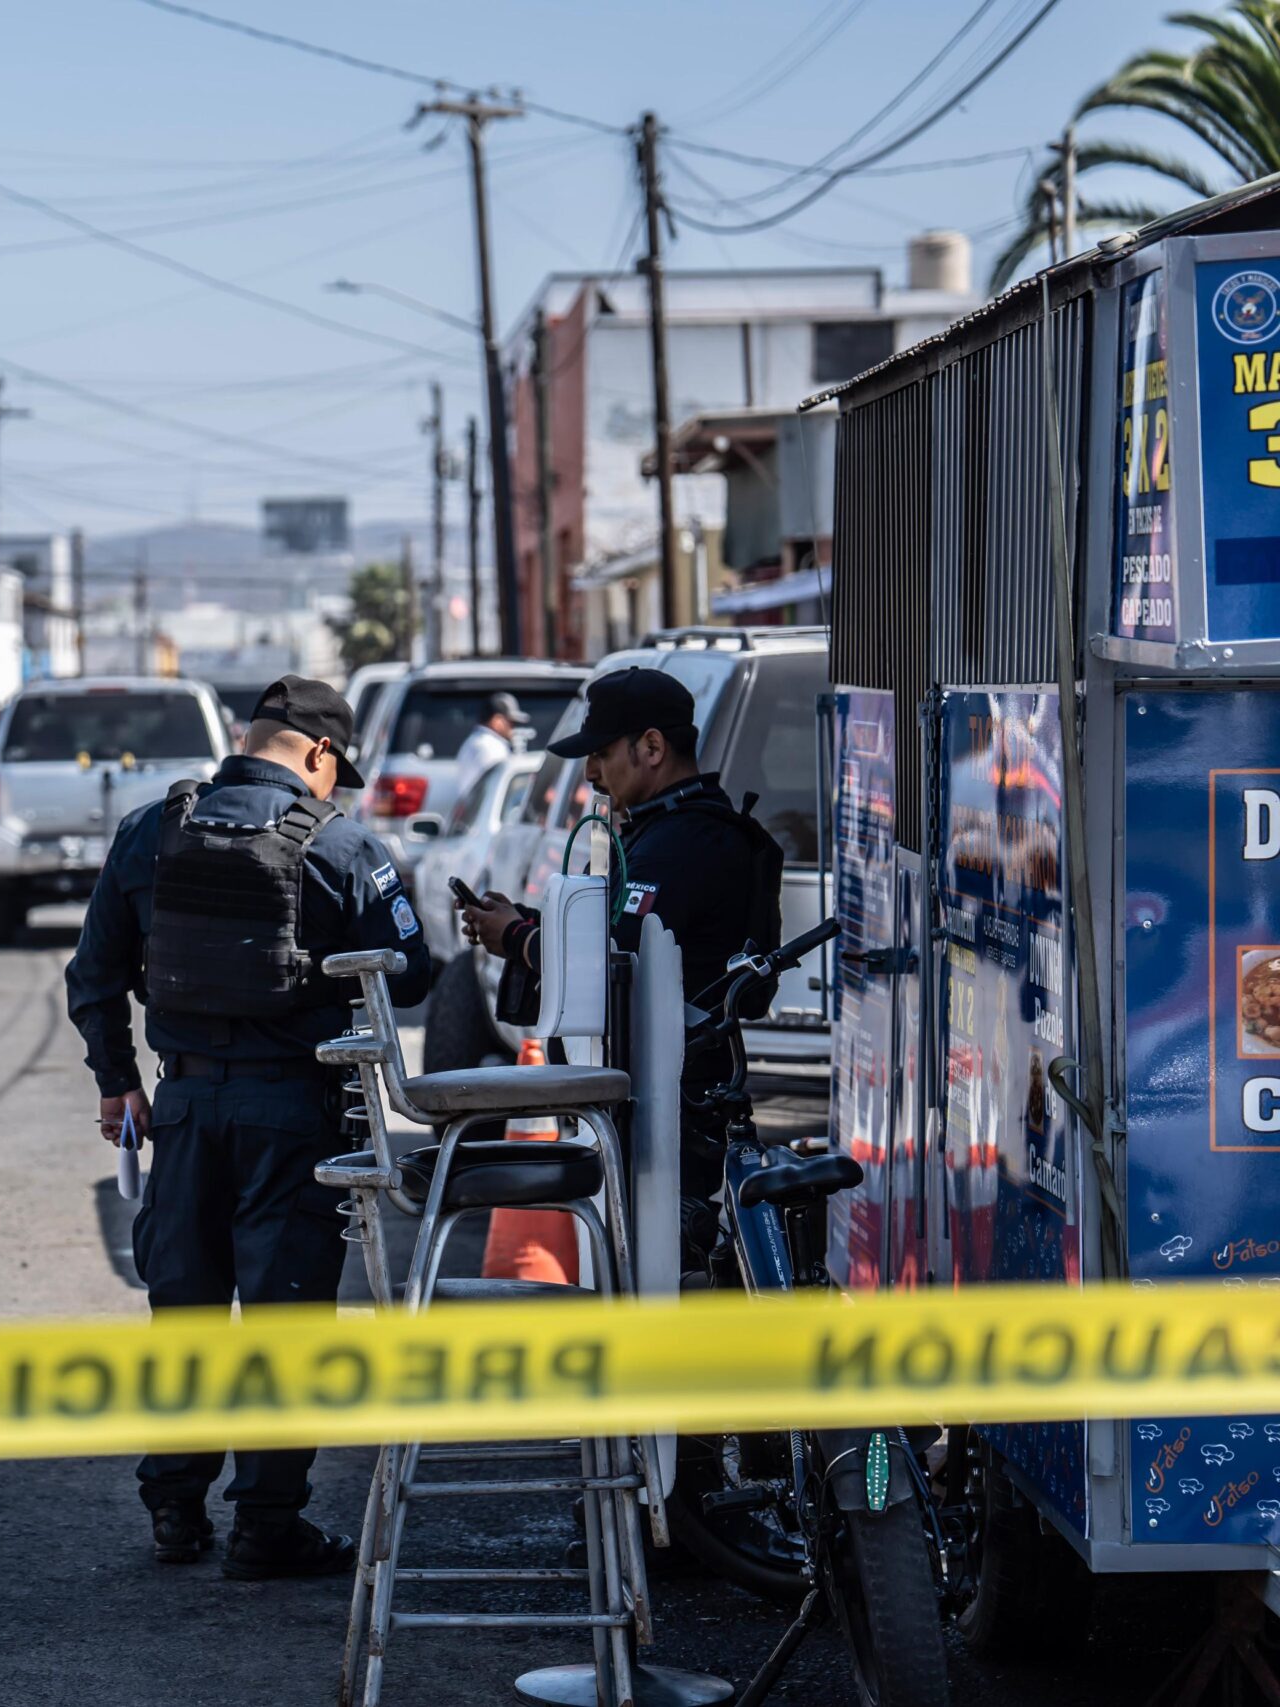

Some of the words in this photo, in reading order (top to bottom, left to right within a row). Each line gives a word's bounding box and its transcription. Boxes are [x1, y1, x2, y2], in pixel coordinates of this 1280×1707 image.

[1122, 416, 1133, 497] 3
[1138, 413, 1150, 493] X
[1152, 407, 1170, 491] 2
[1122, 553, 1171, 583] PESCADO
[1121, 597, 1173, 627] CAPEADO
[626, 881, 656, 893] MÉXICO
[947, 976, 954, 1026] 3
[957, 980, 964, 1032] X
[966, 984, 974, 1037] 2
[1034, 996, 1064, 1050] Pozole
[945, 1055, 974, 1087] PESCAD
[1045, 1078, 1058, 1121] de
[1029, 1142, 1067, 1203] Camaró
